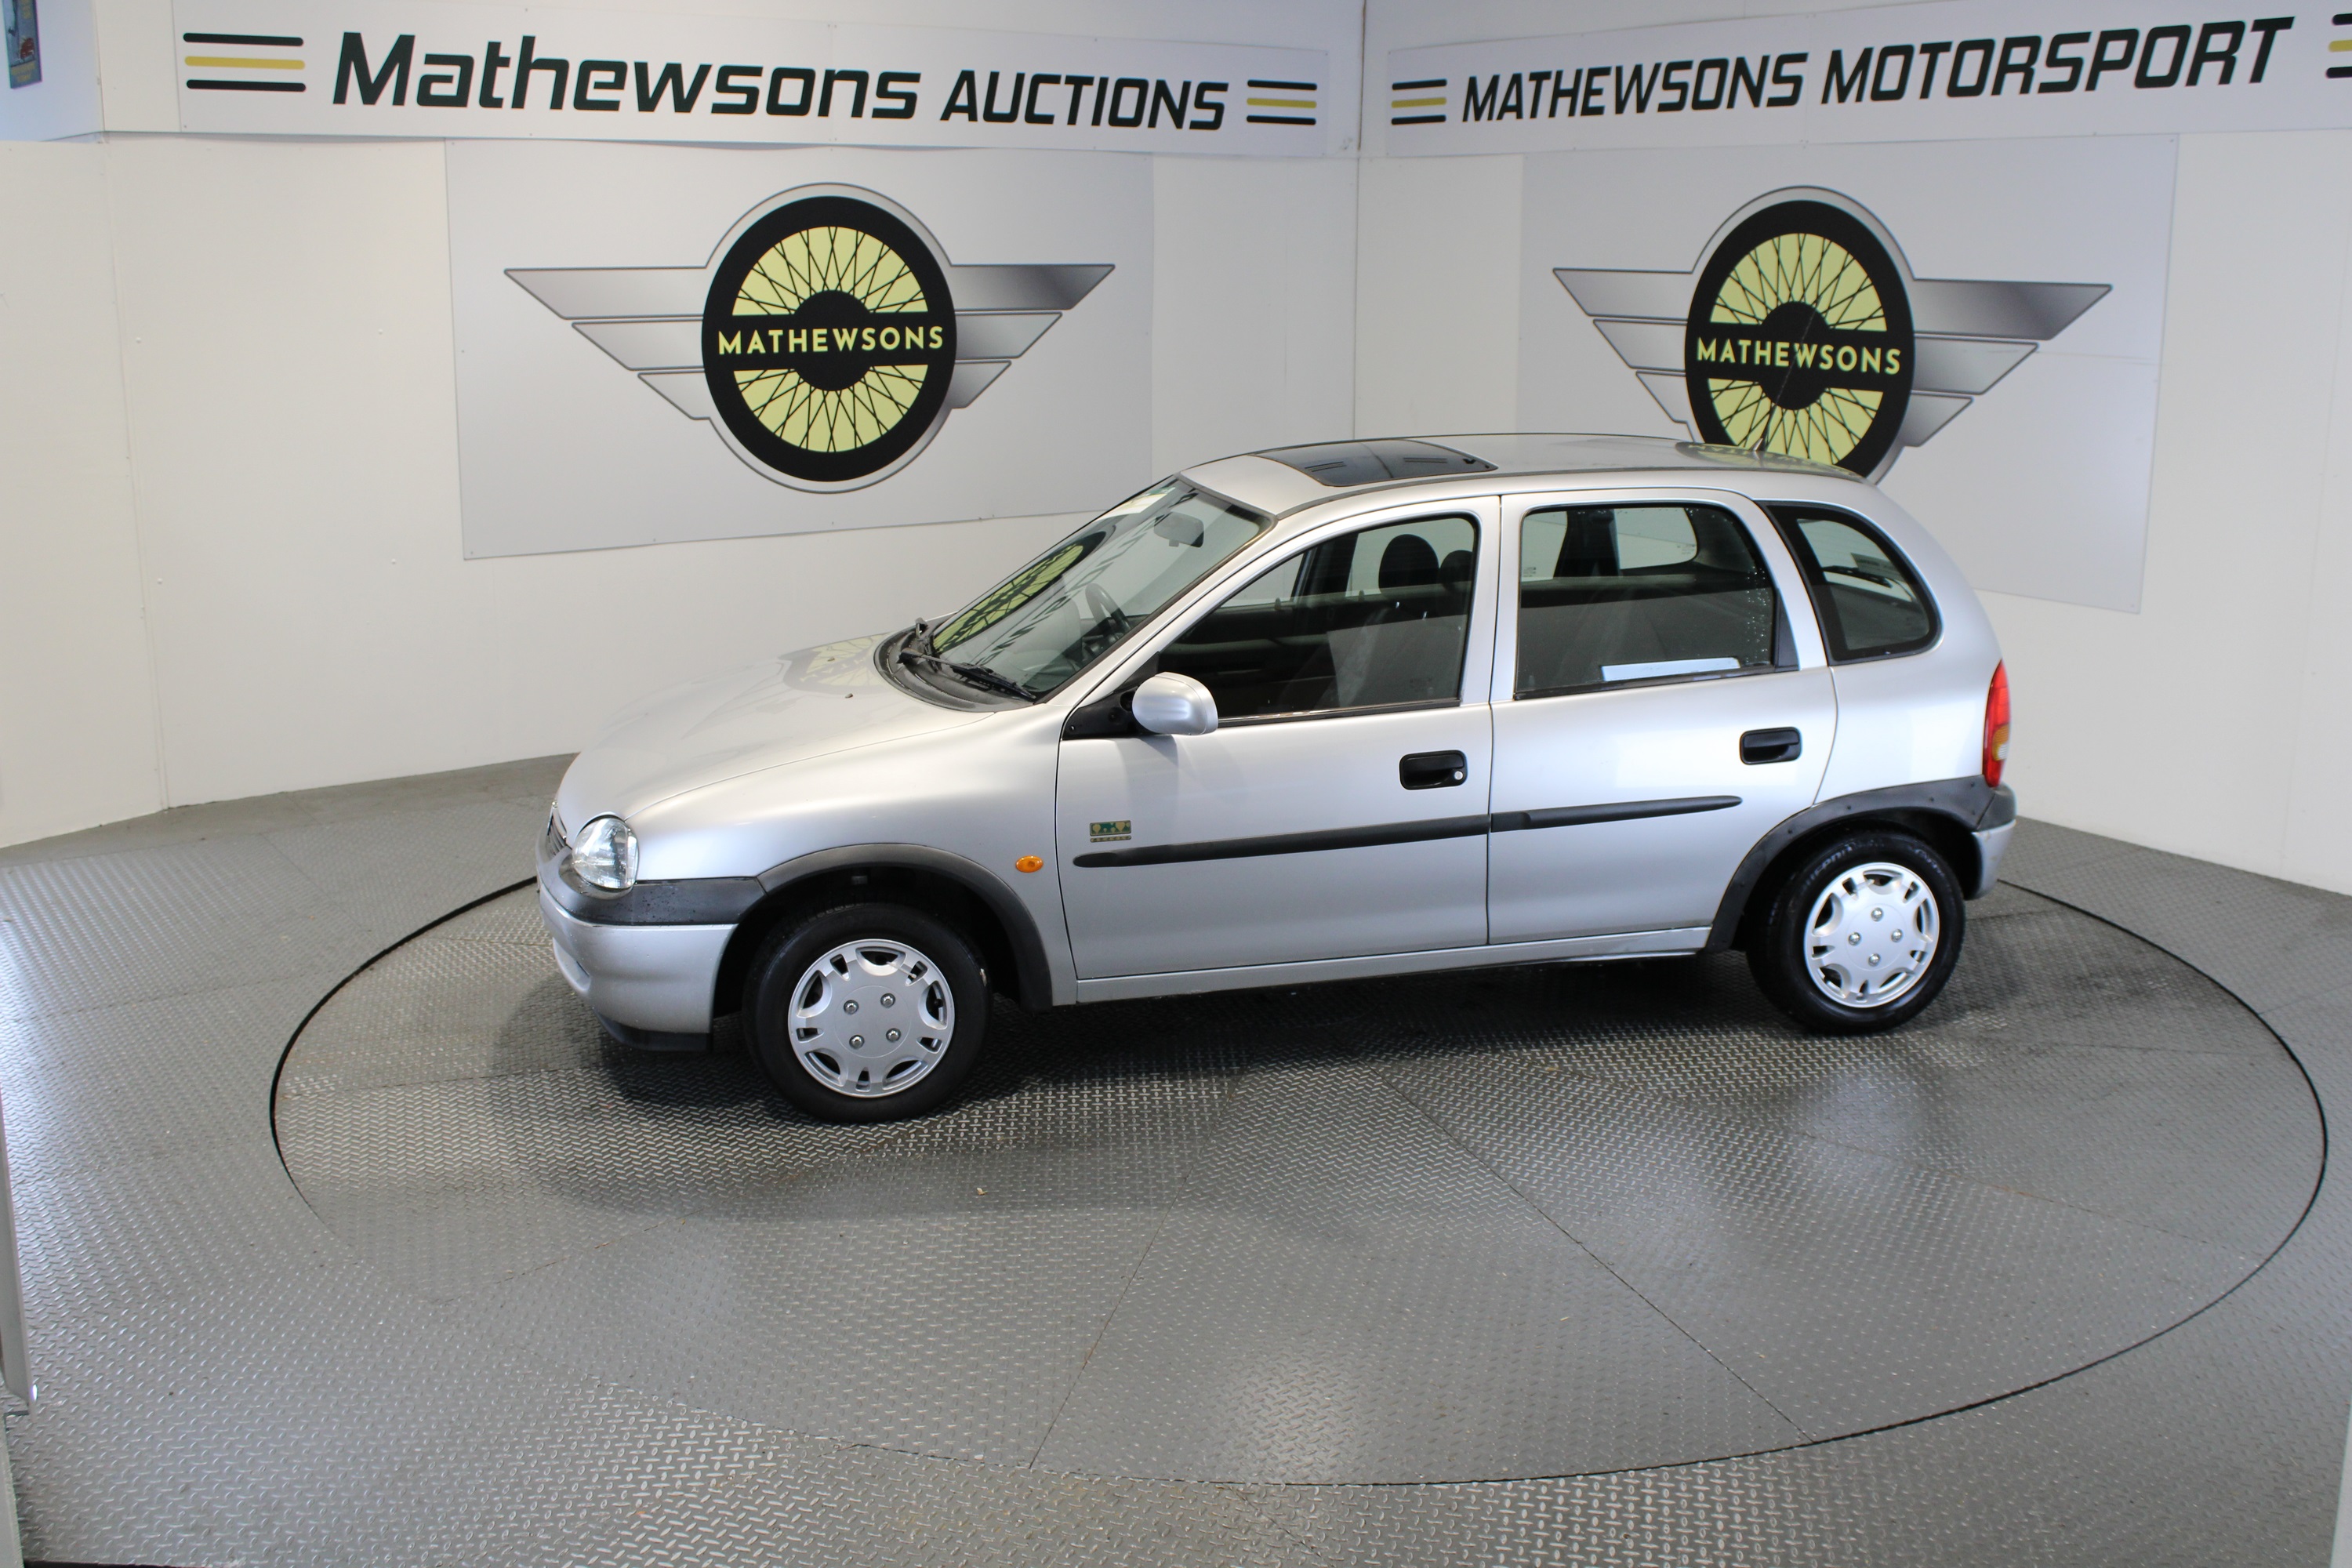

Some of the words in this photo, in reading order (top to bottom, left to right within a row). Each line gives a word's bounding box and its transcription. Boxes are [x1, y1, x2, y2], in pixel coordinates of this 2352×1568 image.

[332, 31, 921, 119] Mathewsons
[939, 70, 1229, 131] AUCTIONS
[1461, 52, 1809, 123] MATHEWSONS
[1820, 16, 2296, 105] MOTORSPORT
[717, 325, 944, 355] MATHEWSONS
[1697, 336, 1901, 376] MATHEWSONS
